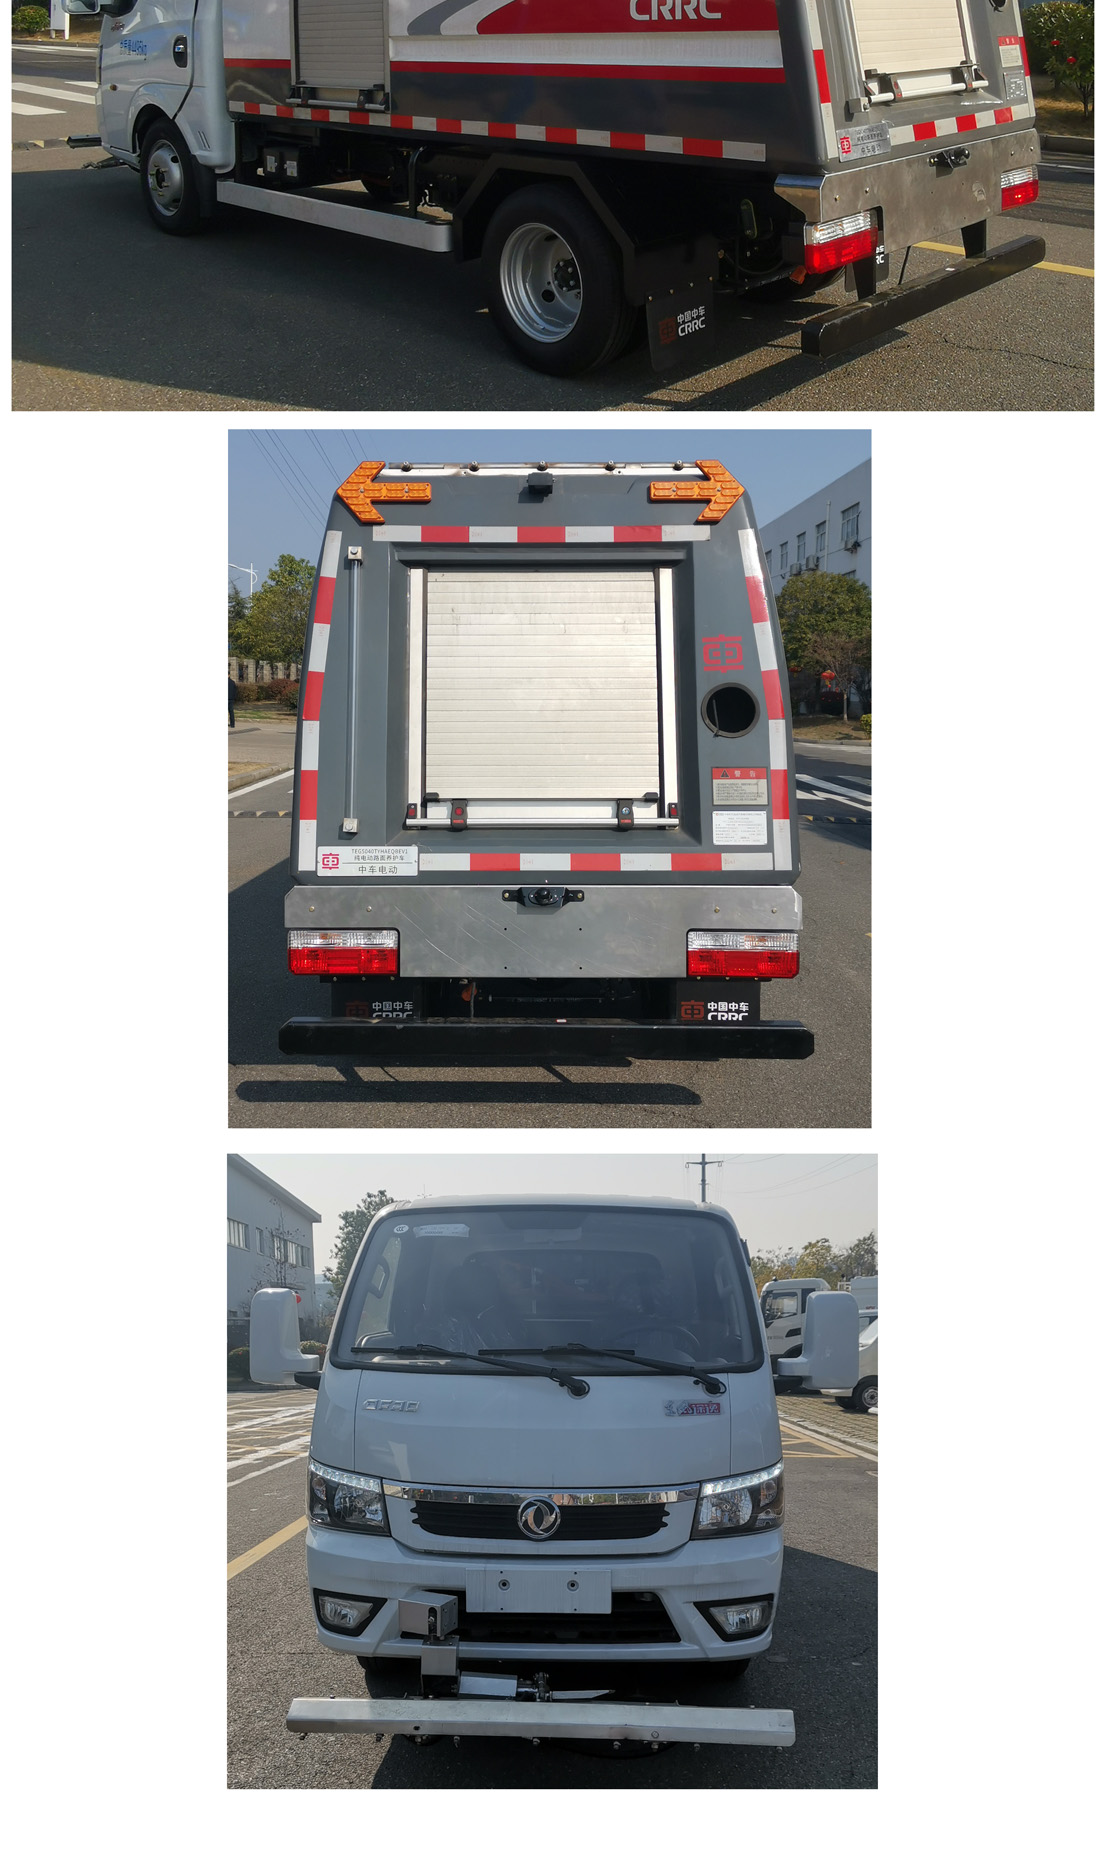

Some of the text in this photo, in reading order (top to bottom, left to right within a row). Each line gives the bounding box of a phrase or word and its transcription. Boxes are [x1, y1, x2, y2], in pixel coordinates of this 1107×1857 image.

[677, 305, 706, 325] 中国中车
[678, 316, 706, 337] CRRC
[358, 865, 398, 875] 中车电动
[372, 1001, 413, 1011] 中国中车
[707, 1002, 749, 1012] 中国中车
